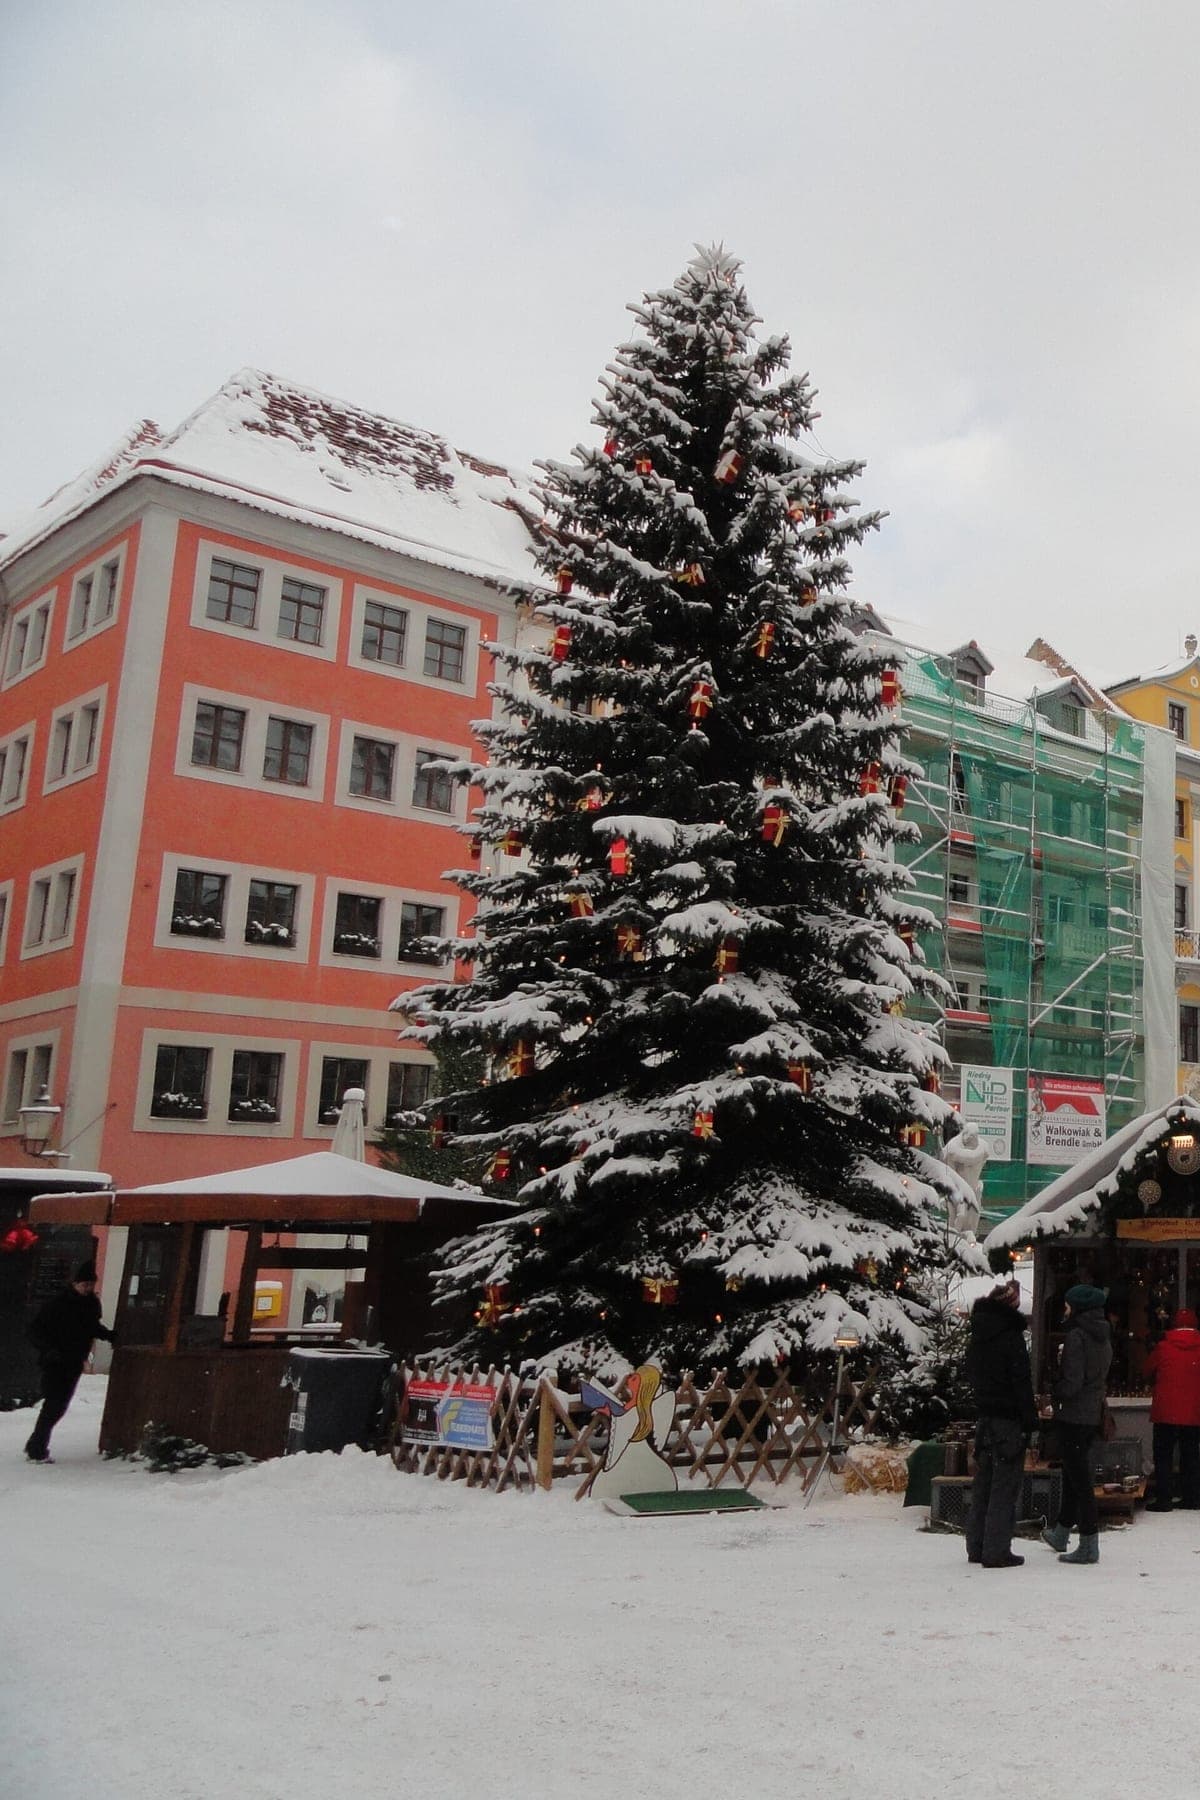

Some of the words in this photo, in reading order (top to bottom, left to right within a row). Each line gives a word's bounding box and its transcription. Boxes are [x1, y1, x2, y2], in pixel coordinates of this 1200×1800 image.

[1045, 1125, 1090, 1137] Walkowiak
[1093, 1127, 1102, 1137] &
[1045, 1136, 1080, 1147] Brendle
